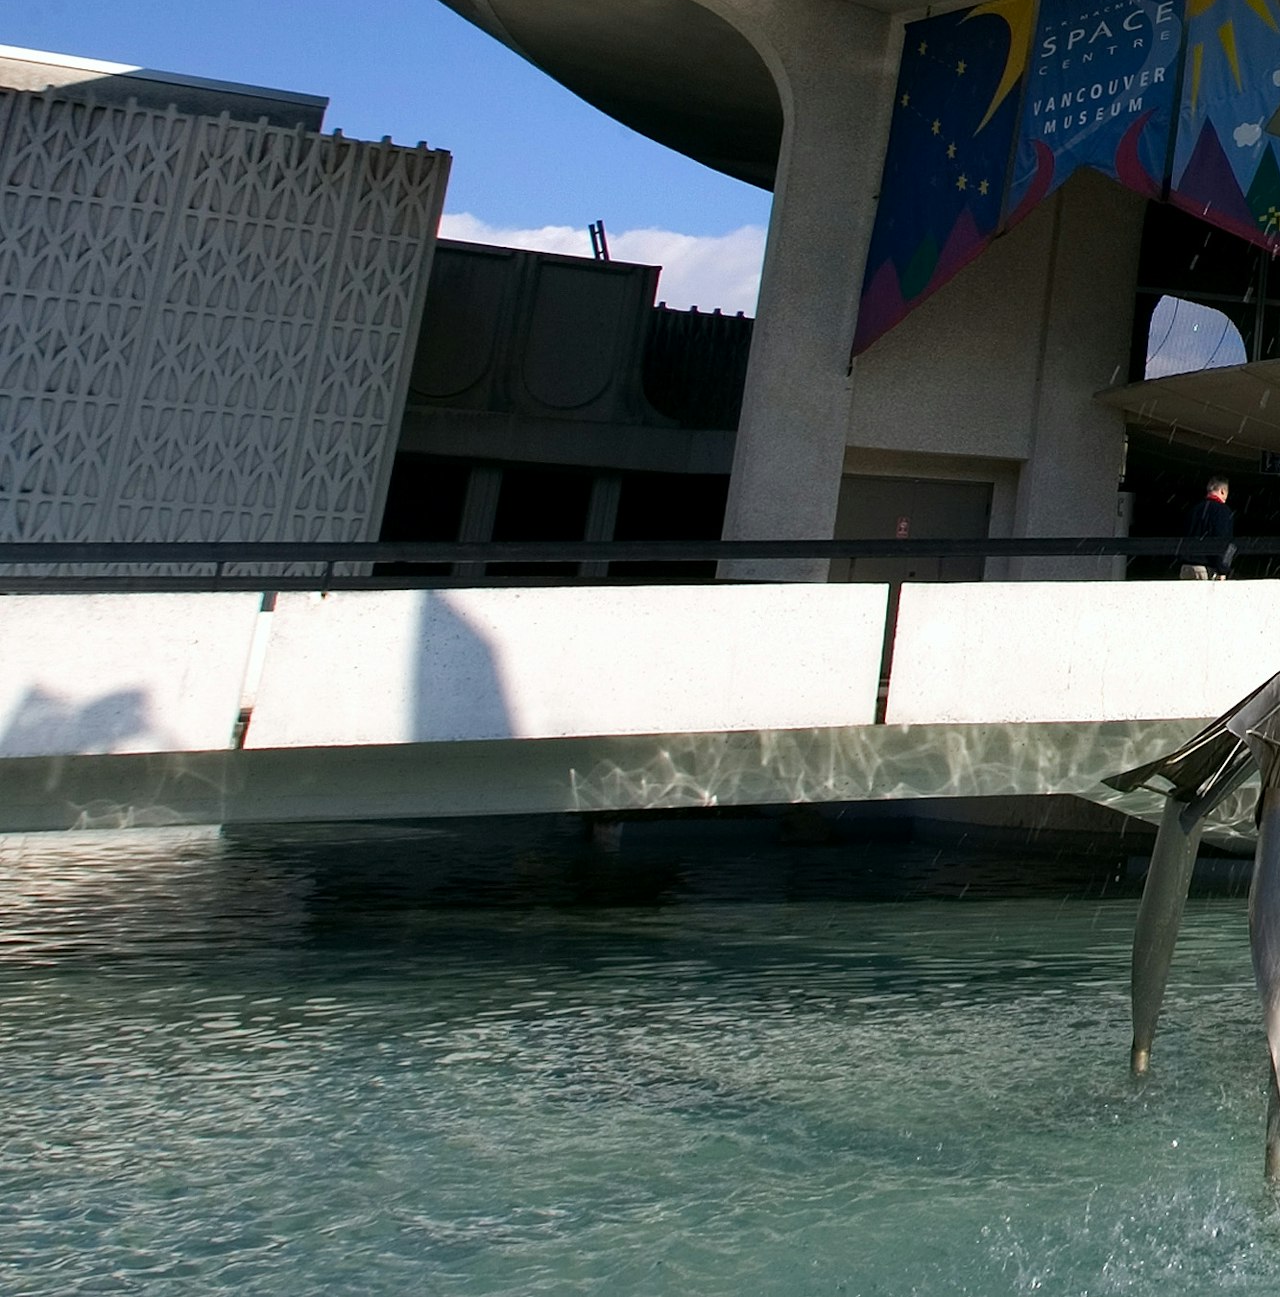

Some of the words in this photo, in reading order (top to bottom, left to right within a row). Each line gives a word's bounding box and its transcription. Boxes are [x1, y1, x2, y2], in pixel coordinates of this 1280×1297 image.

[1039, 30, 1170, 75] CENTRE
[1041, 1, 1174, 58] SPACE
[1034, 67, 1165, 116] VANCOUVER
[1044, 97, 1143, 134] MUSEUM
